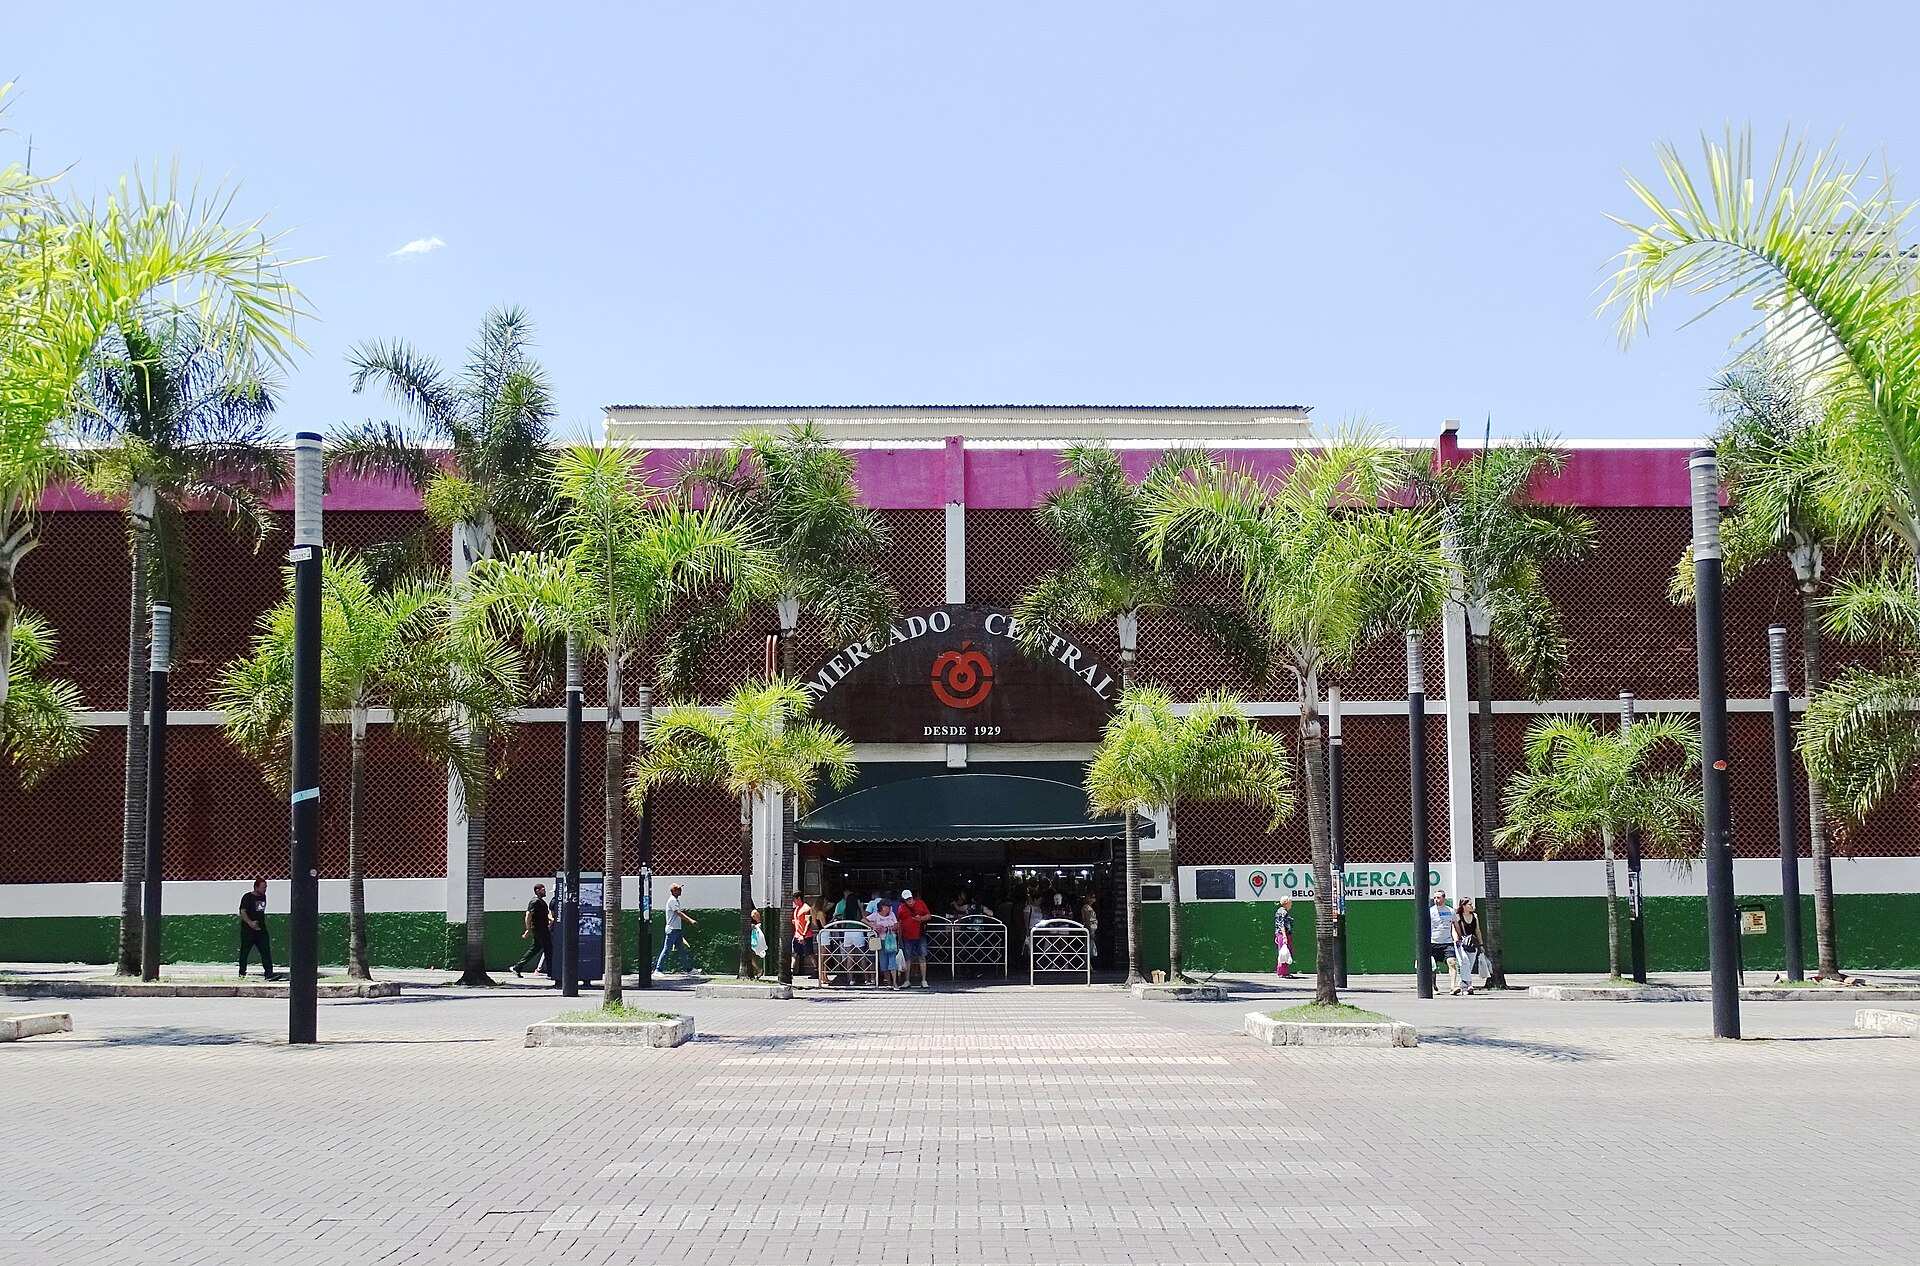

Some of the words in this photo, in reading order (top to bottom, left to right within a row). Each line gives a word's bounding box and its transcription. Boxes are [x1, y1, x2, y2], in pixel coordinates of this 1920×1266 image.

[984, 613, 1114, 700] CETRAL
[923, 725, 967, 736] DESDE
[974, 725, 1001, 736] 1929
[1271, 867, 1298, 889] TÔ
[1343, 870, 1441, 888] MERCAO
[1291, 889, 1315, 897] BELO
